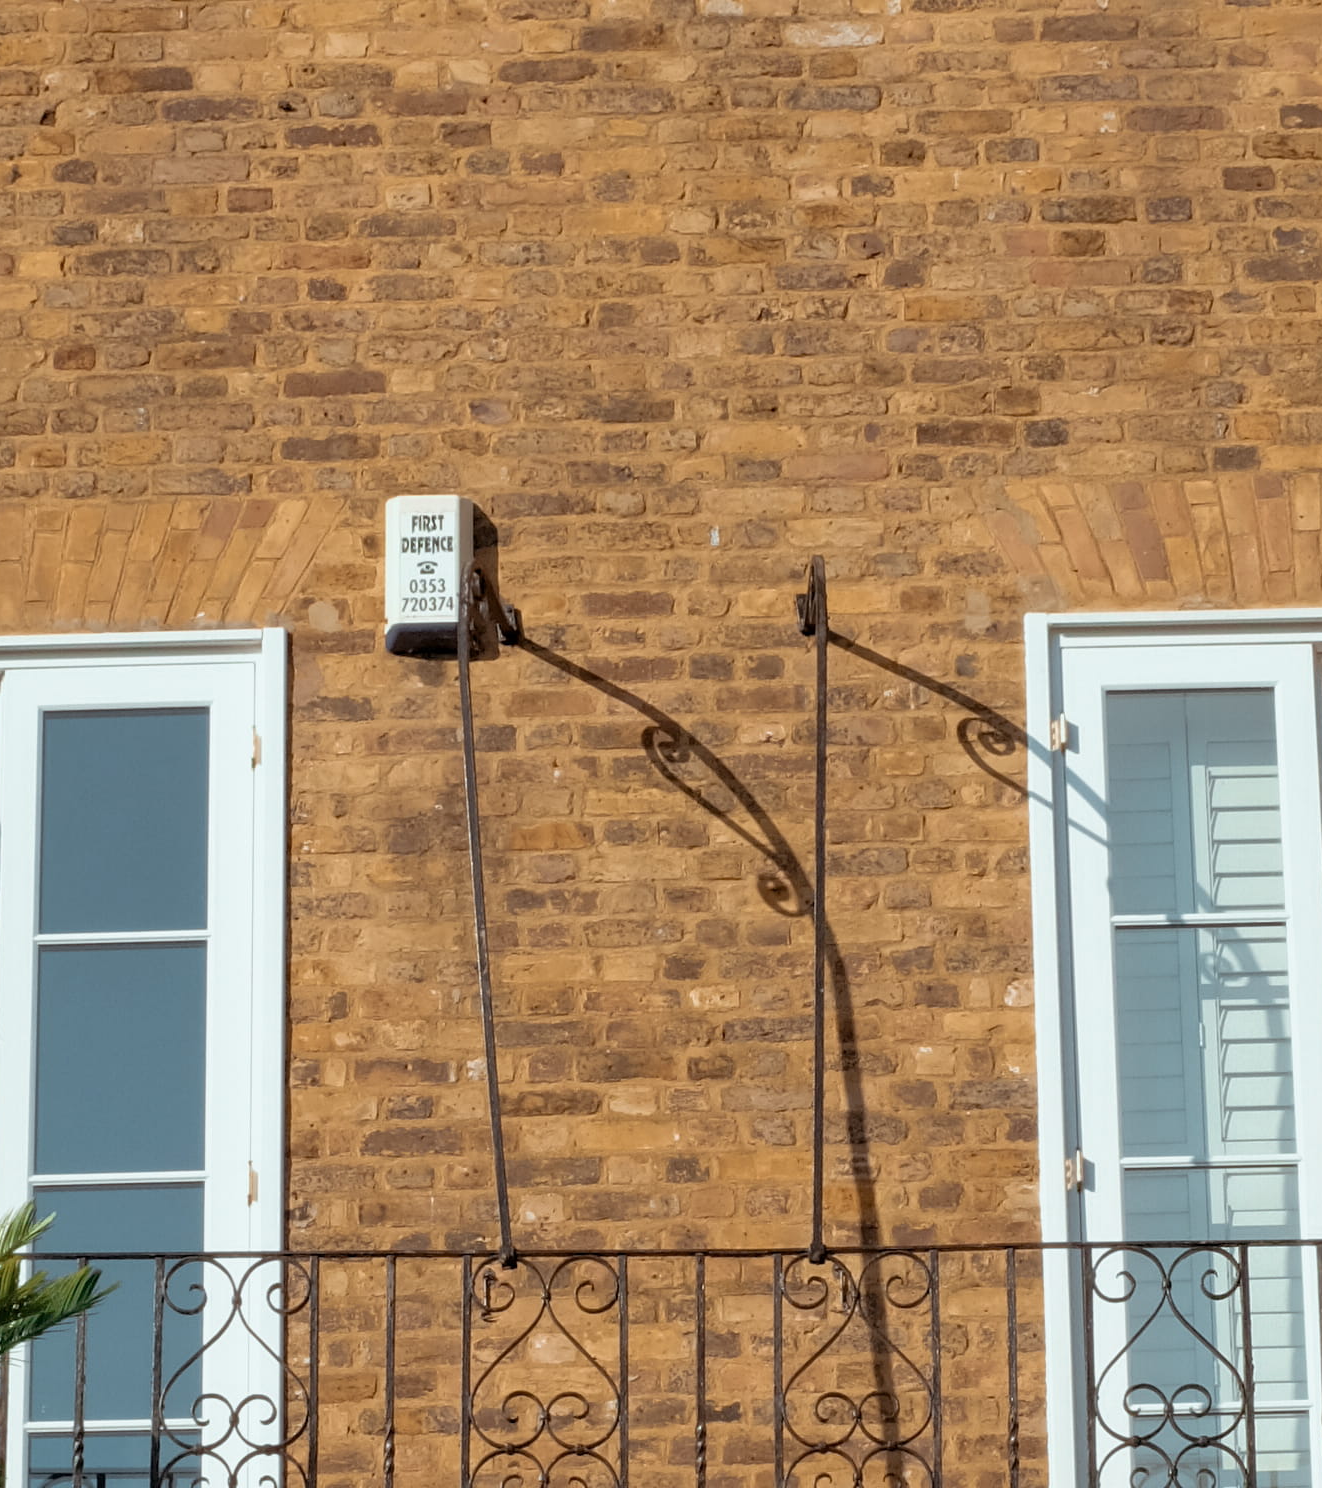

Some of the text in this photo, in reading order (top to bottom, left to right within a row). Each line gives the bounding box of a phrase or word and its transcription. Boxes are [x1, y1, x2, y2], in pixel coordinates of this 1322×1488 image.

[411, 514, 445, 533] FIRST
[401, 535, 454, 554] DEFENCE
[409, 578, 446, 594] 0353
[401, 596, 454, 612] 720374
